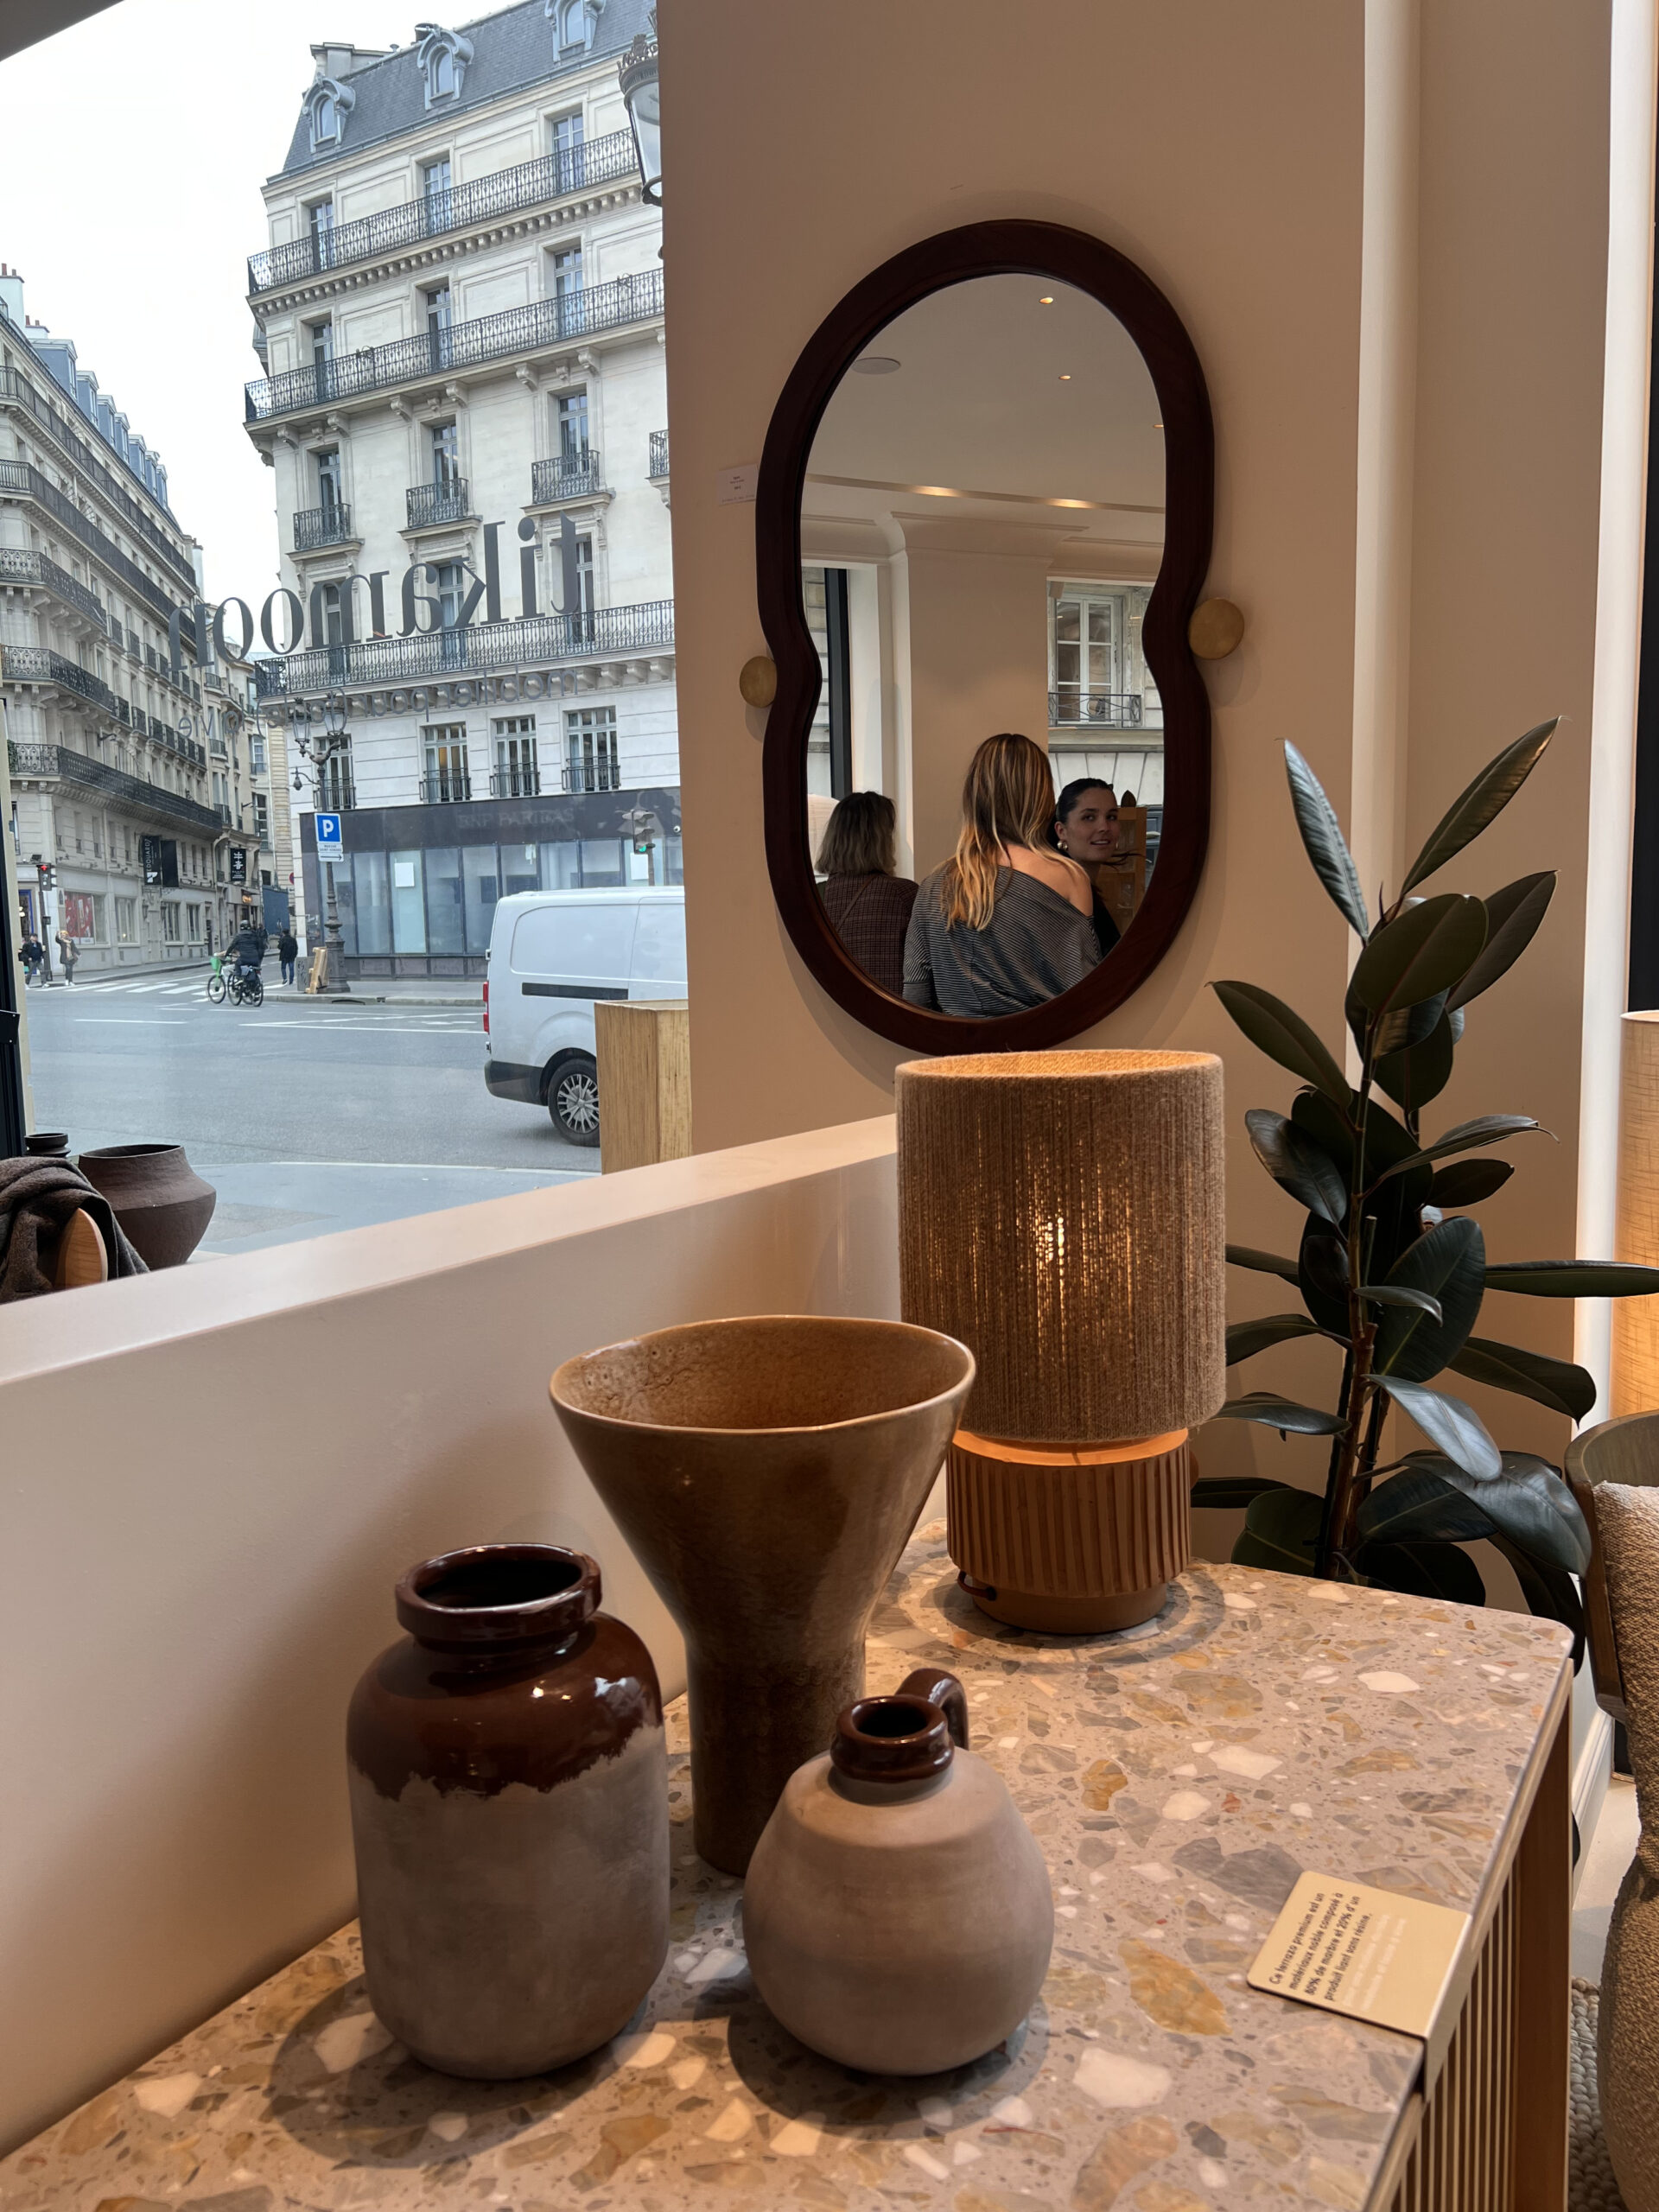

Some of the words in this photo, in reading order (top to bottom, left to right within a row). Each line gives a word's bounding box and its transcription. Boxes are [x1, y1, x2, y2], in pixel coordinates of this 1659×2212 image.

[322, 819, 334, 838] P
[1293, 1913, 1313, 1944] premium
[1309, 1901, 1319, 1912] est
[1309, 1929, 1324, 1950] noble
[1322, 1938, 1339, 1964] marbre
[1325, 1972, 1342, 2001] produit
[1337, 1954, 1351, 1971] liant
[1347, 1937, 1359, 1953] sans
